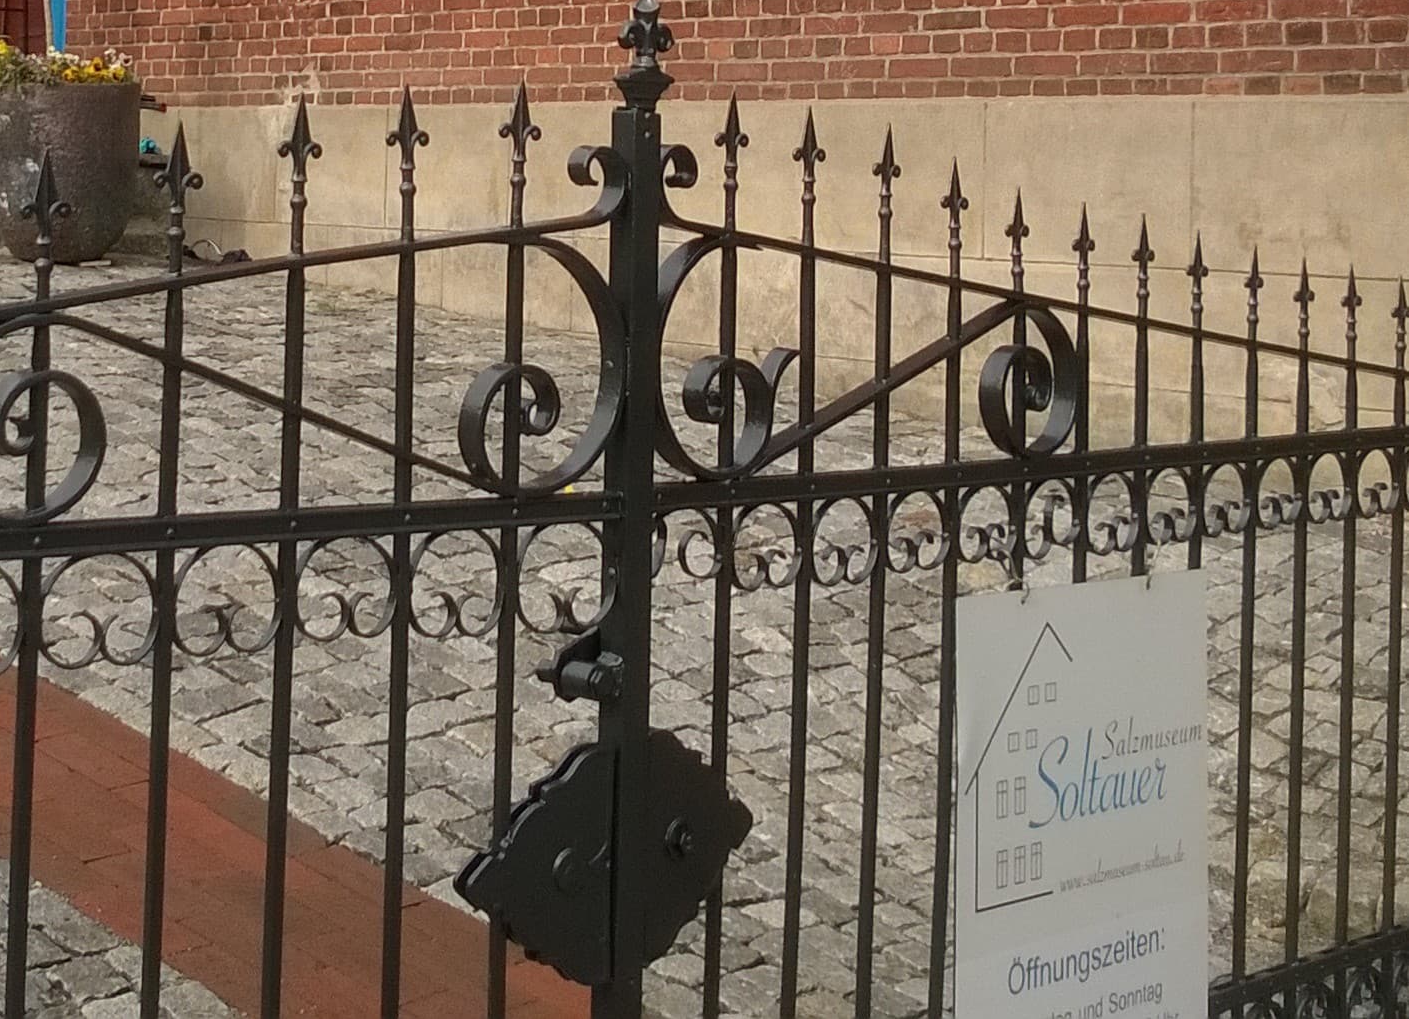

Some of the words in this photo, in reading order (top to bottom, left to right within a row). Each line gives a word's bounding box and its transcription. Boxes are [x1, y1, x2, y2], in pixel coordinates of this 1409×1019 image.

[1101, 715, 1202, 760] Salzmuseum
[1028, 727, 1167, 829] Soltauer
[1008, 927, 1166, 996] Öffnungszeiten:
[1078, 996, 1104, 1019] und
[1108, 983, 1163, 1014] Sonntag
